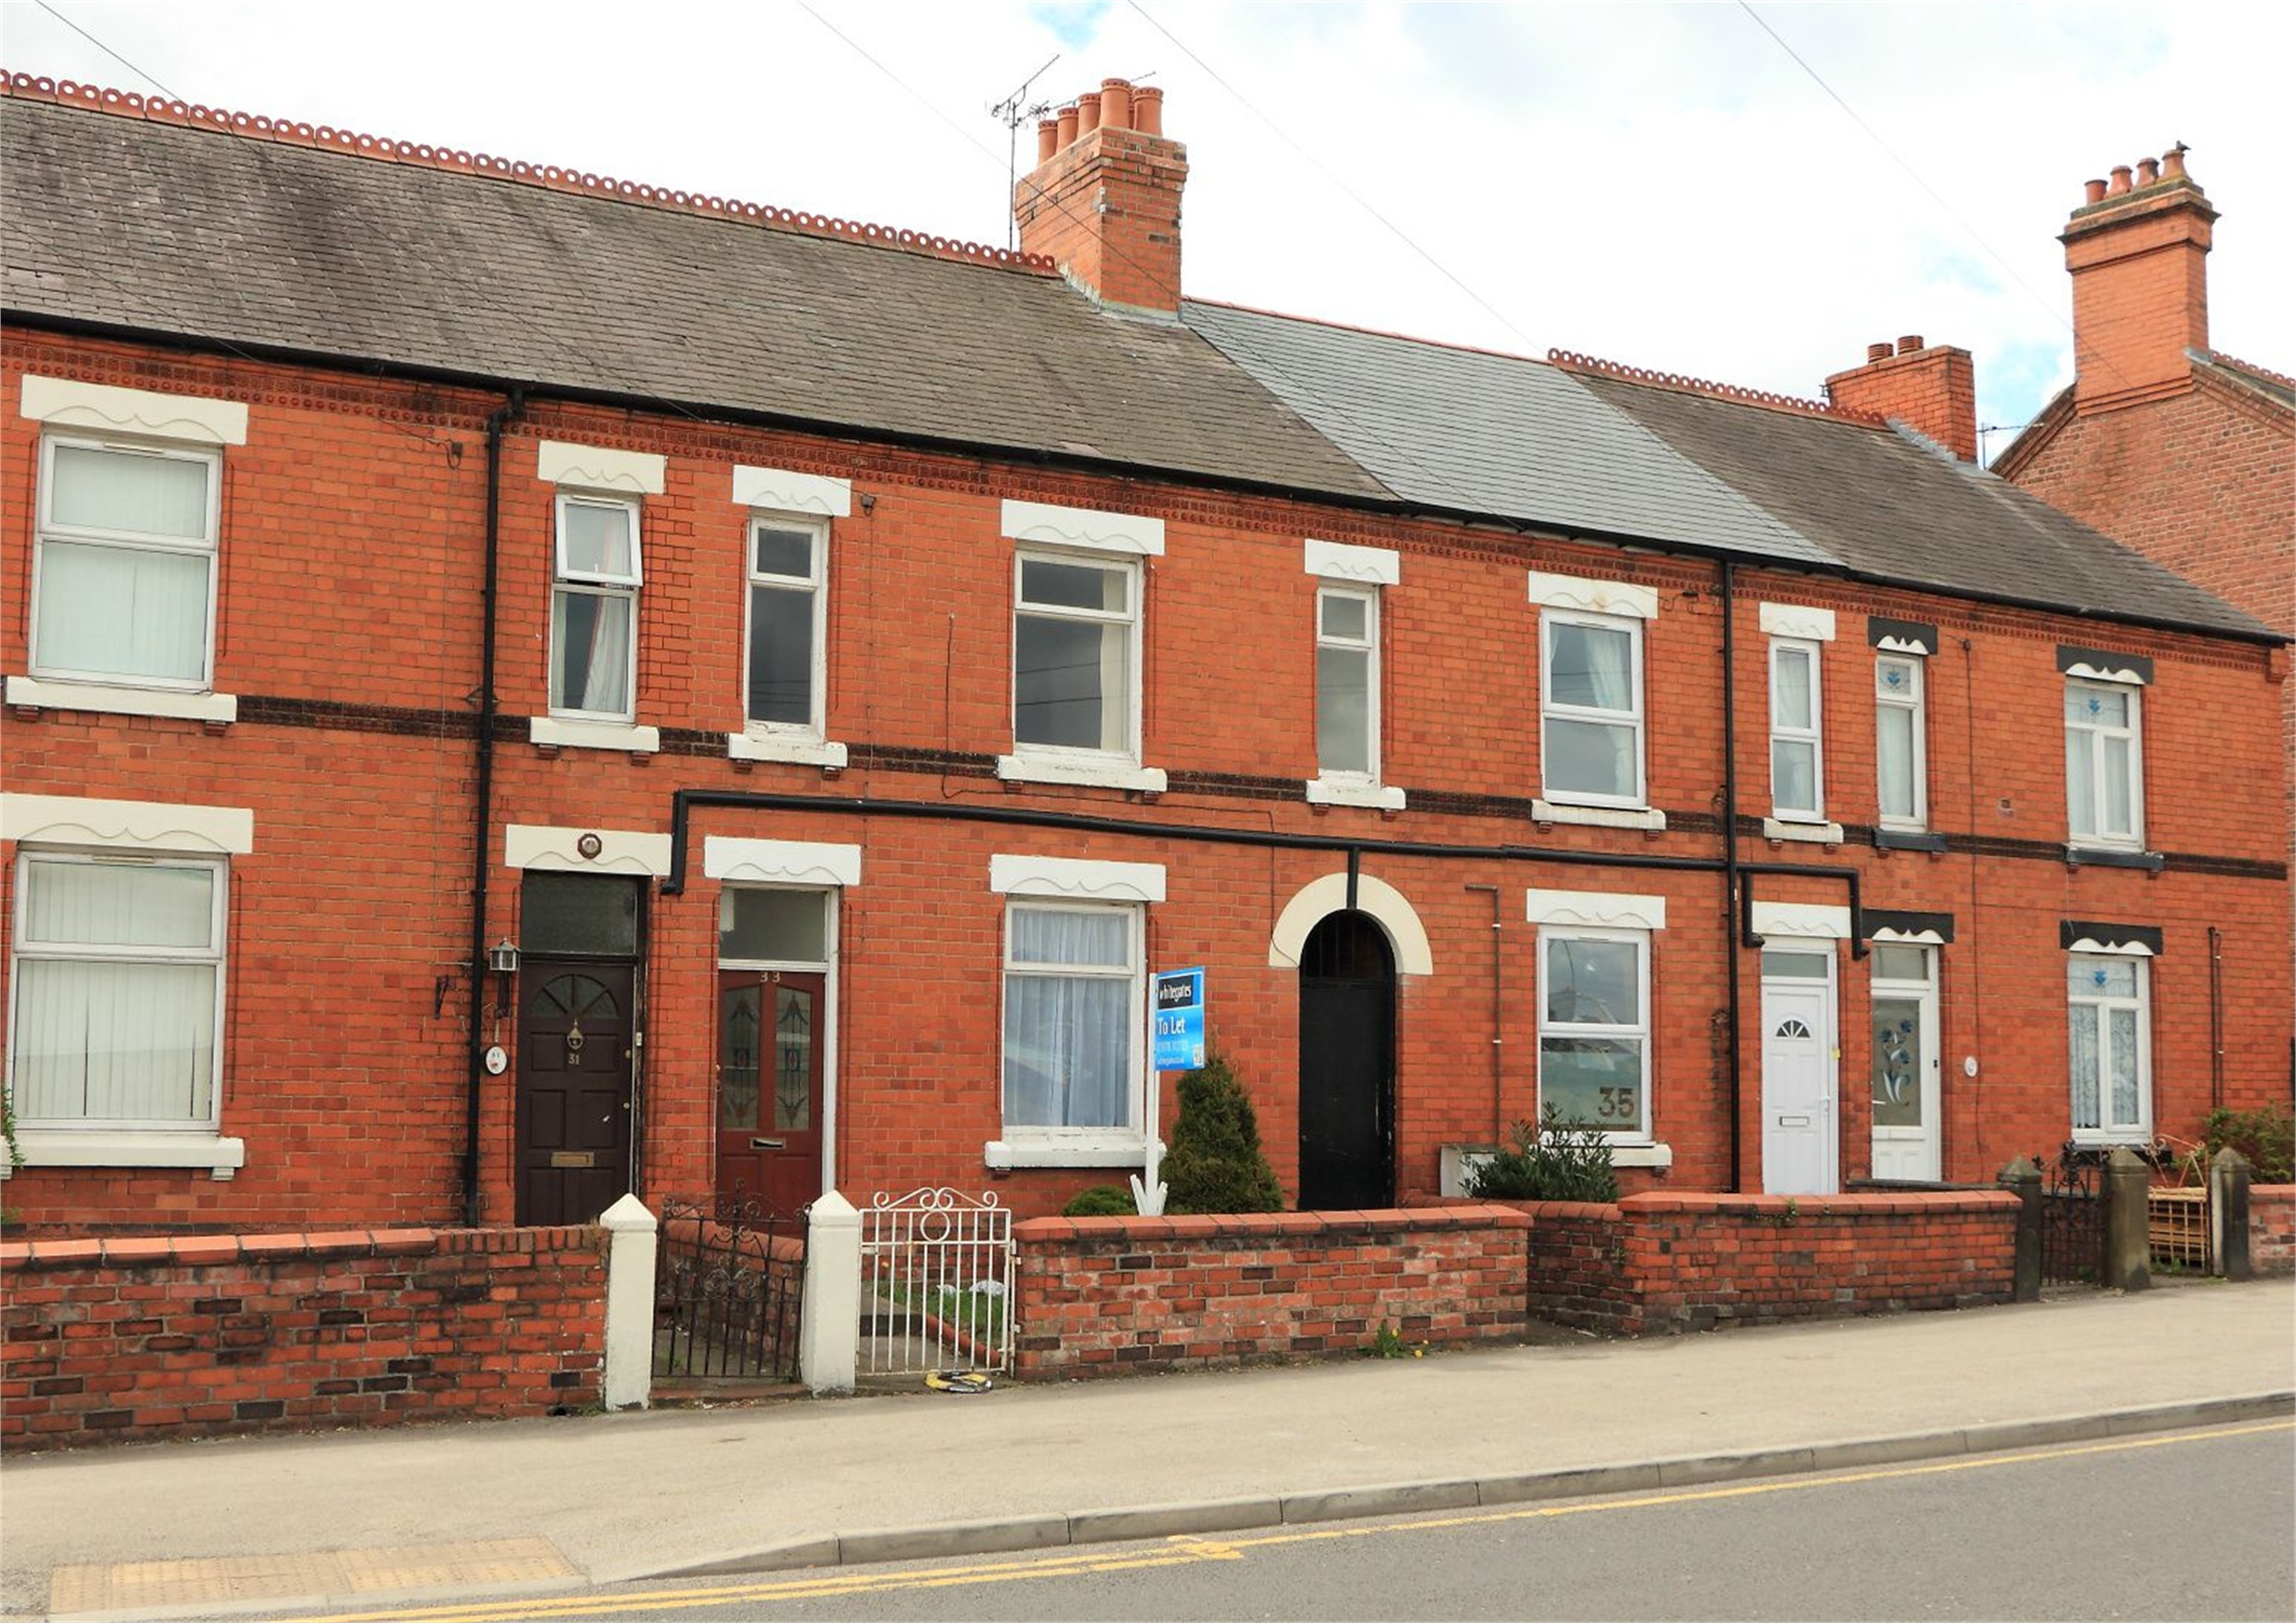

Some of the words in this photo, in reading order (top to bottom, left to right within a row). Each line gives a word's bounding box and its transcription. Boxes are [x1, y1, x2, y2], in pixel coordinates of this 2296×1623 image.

[760, 971, 781, 983] 33
[1157, 1017, 1168, 1035] To
[1170, 1016, 1186, 1034] Let
[568, 1054, 580, 1065] 31
[1599, 1087, 1635, 1118] 35
